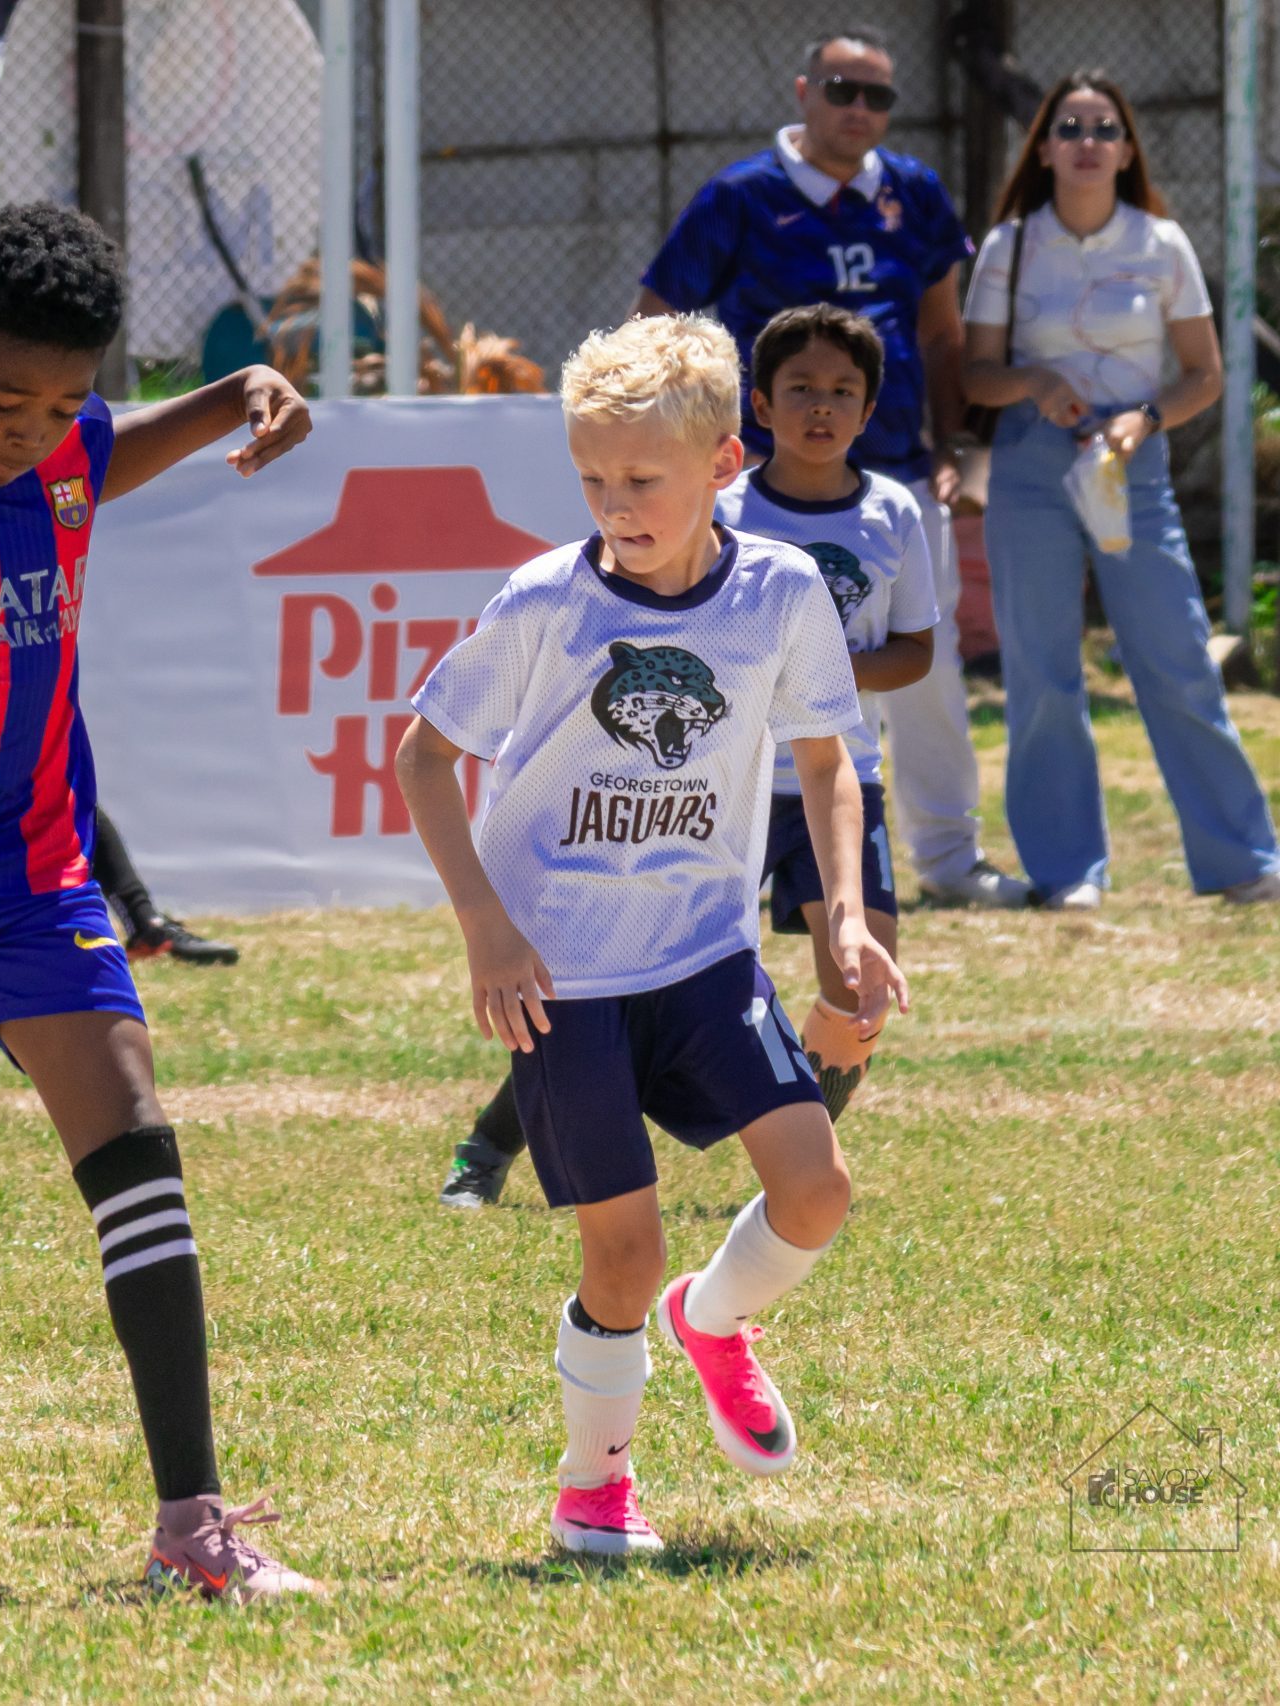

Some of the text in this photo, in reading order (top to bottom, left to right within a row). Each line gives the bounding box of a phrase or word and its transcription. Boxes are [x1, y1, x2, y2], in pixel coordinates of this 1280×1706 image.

[827, 243, 877, 291] 12
[278, 582, 476, 714] Piz
[590, 772, 708, 793] GEORGETOWN
[560, 787, 716, 846] JAGUARS
